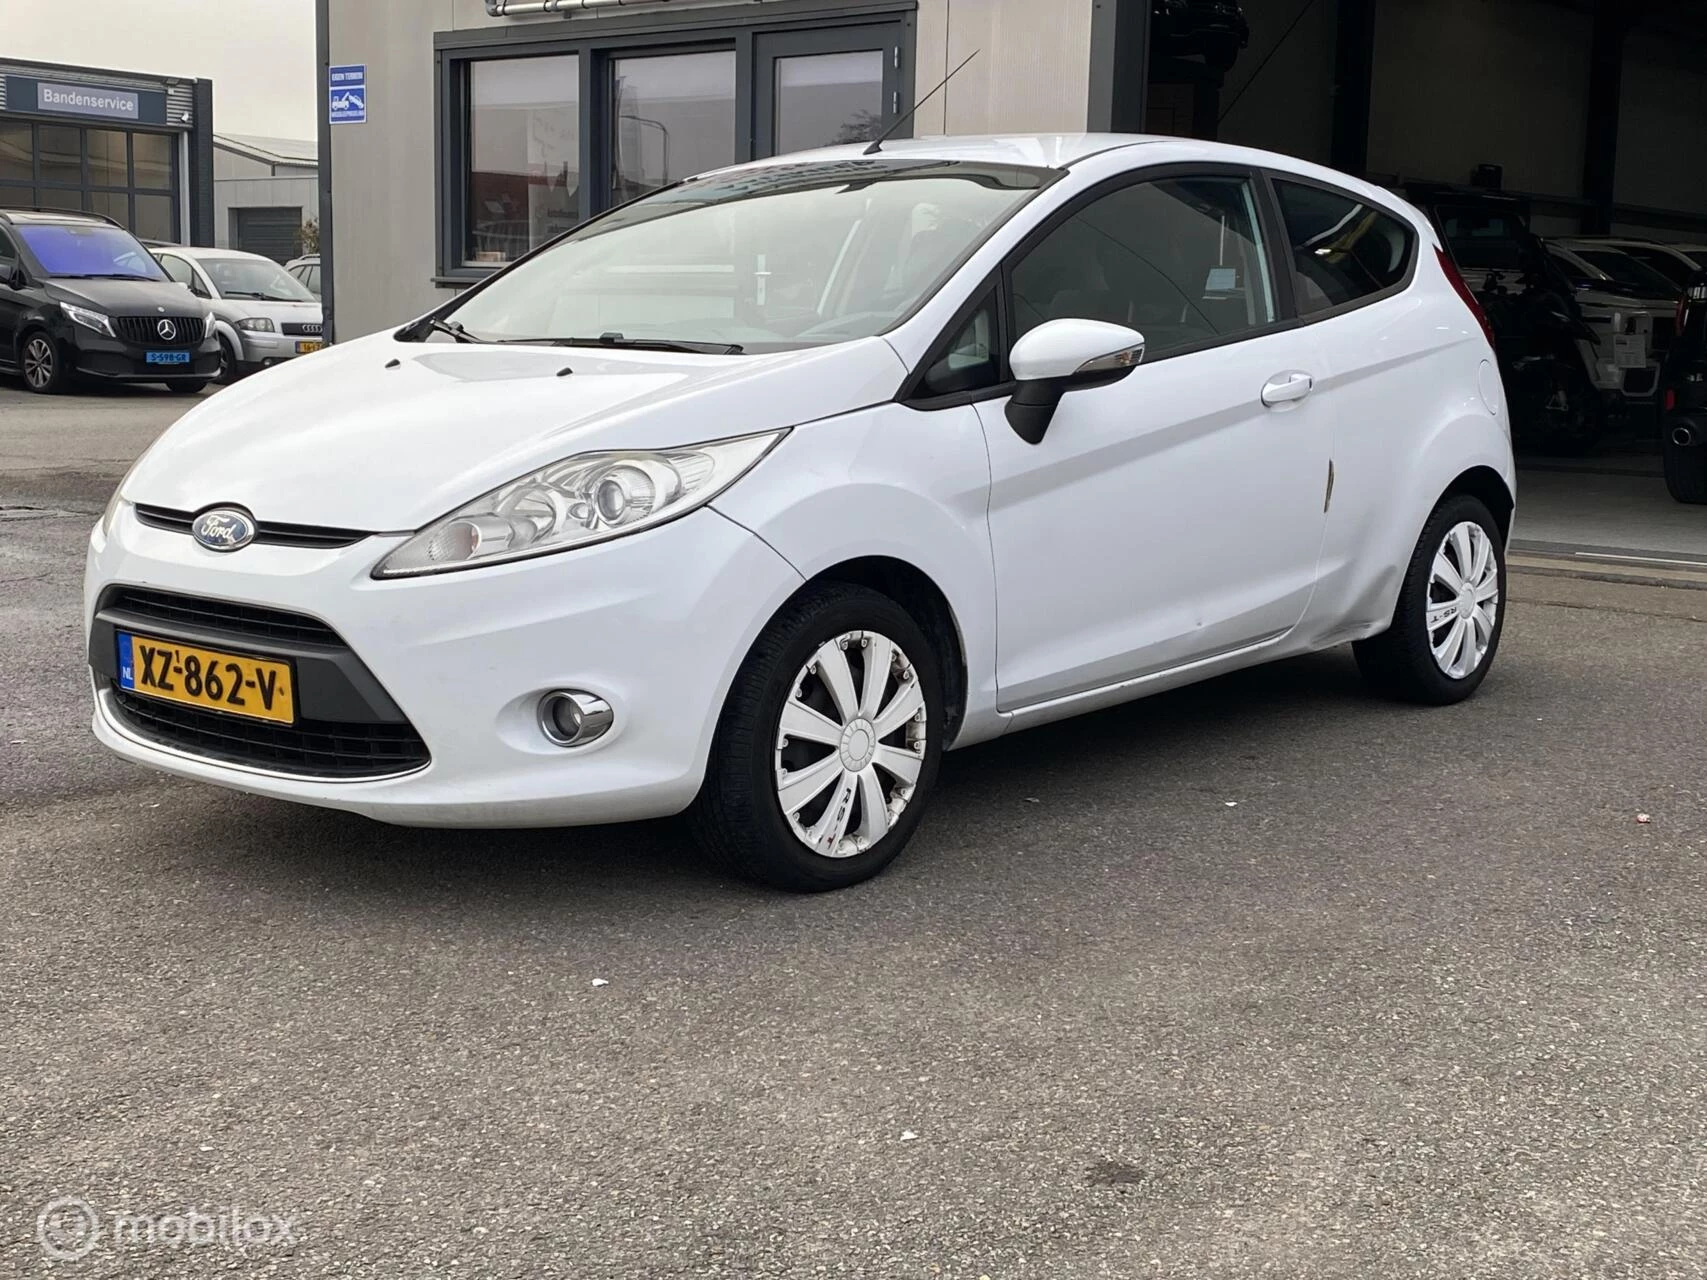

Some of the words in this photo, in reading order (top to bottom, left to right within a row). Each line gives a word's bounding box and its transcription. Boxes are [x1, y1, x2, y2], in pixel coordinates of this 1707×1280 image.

[43, 88, 134, 111] Bandenservice
[200, 514, 237, 539] Ford
[122, 666, 134, 681] NL
[139, 644, 277, 711] XZ-862-V
